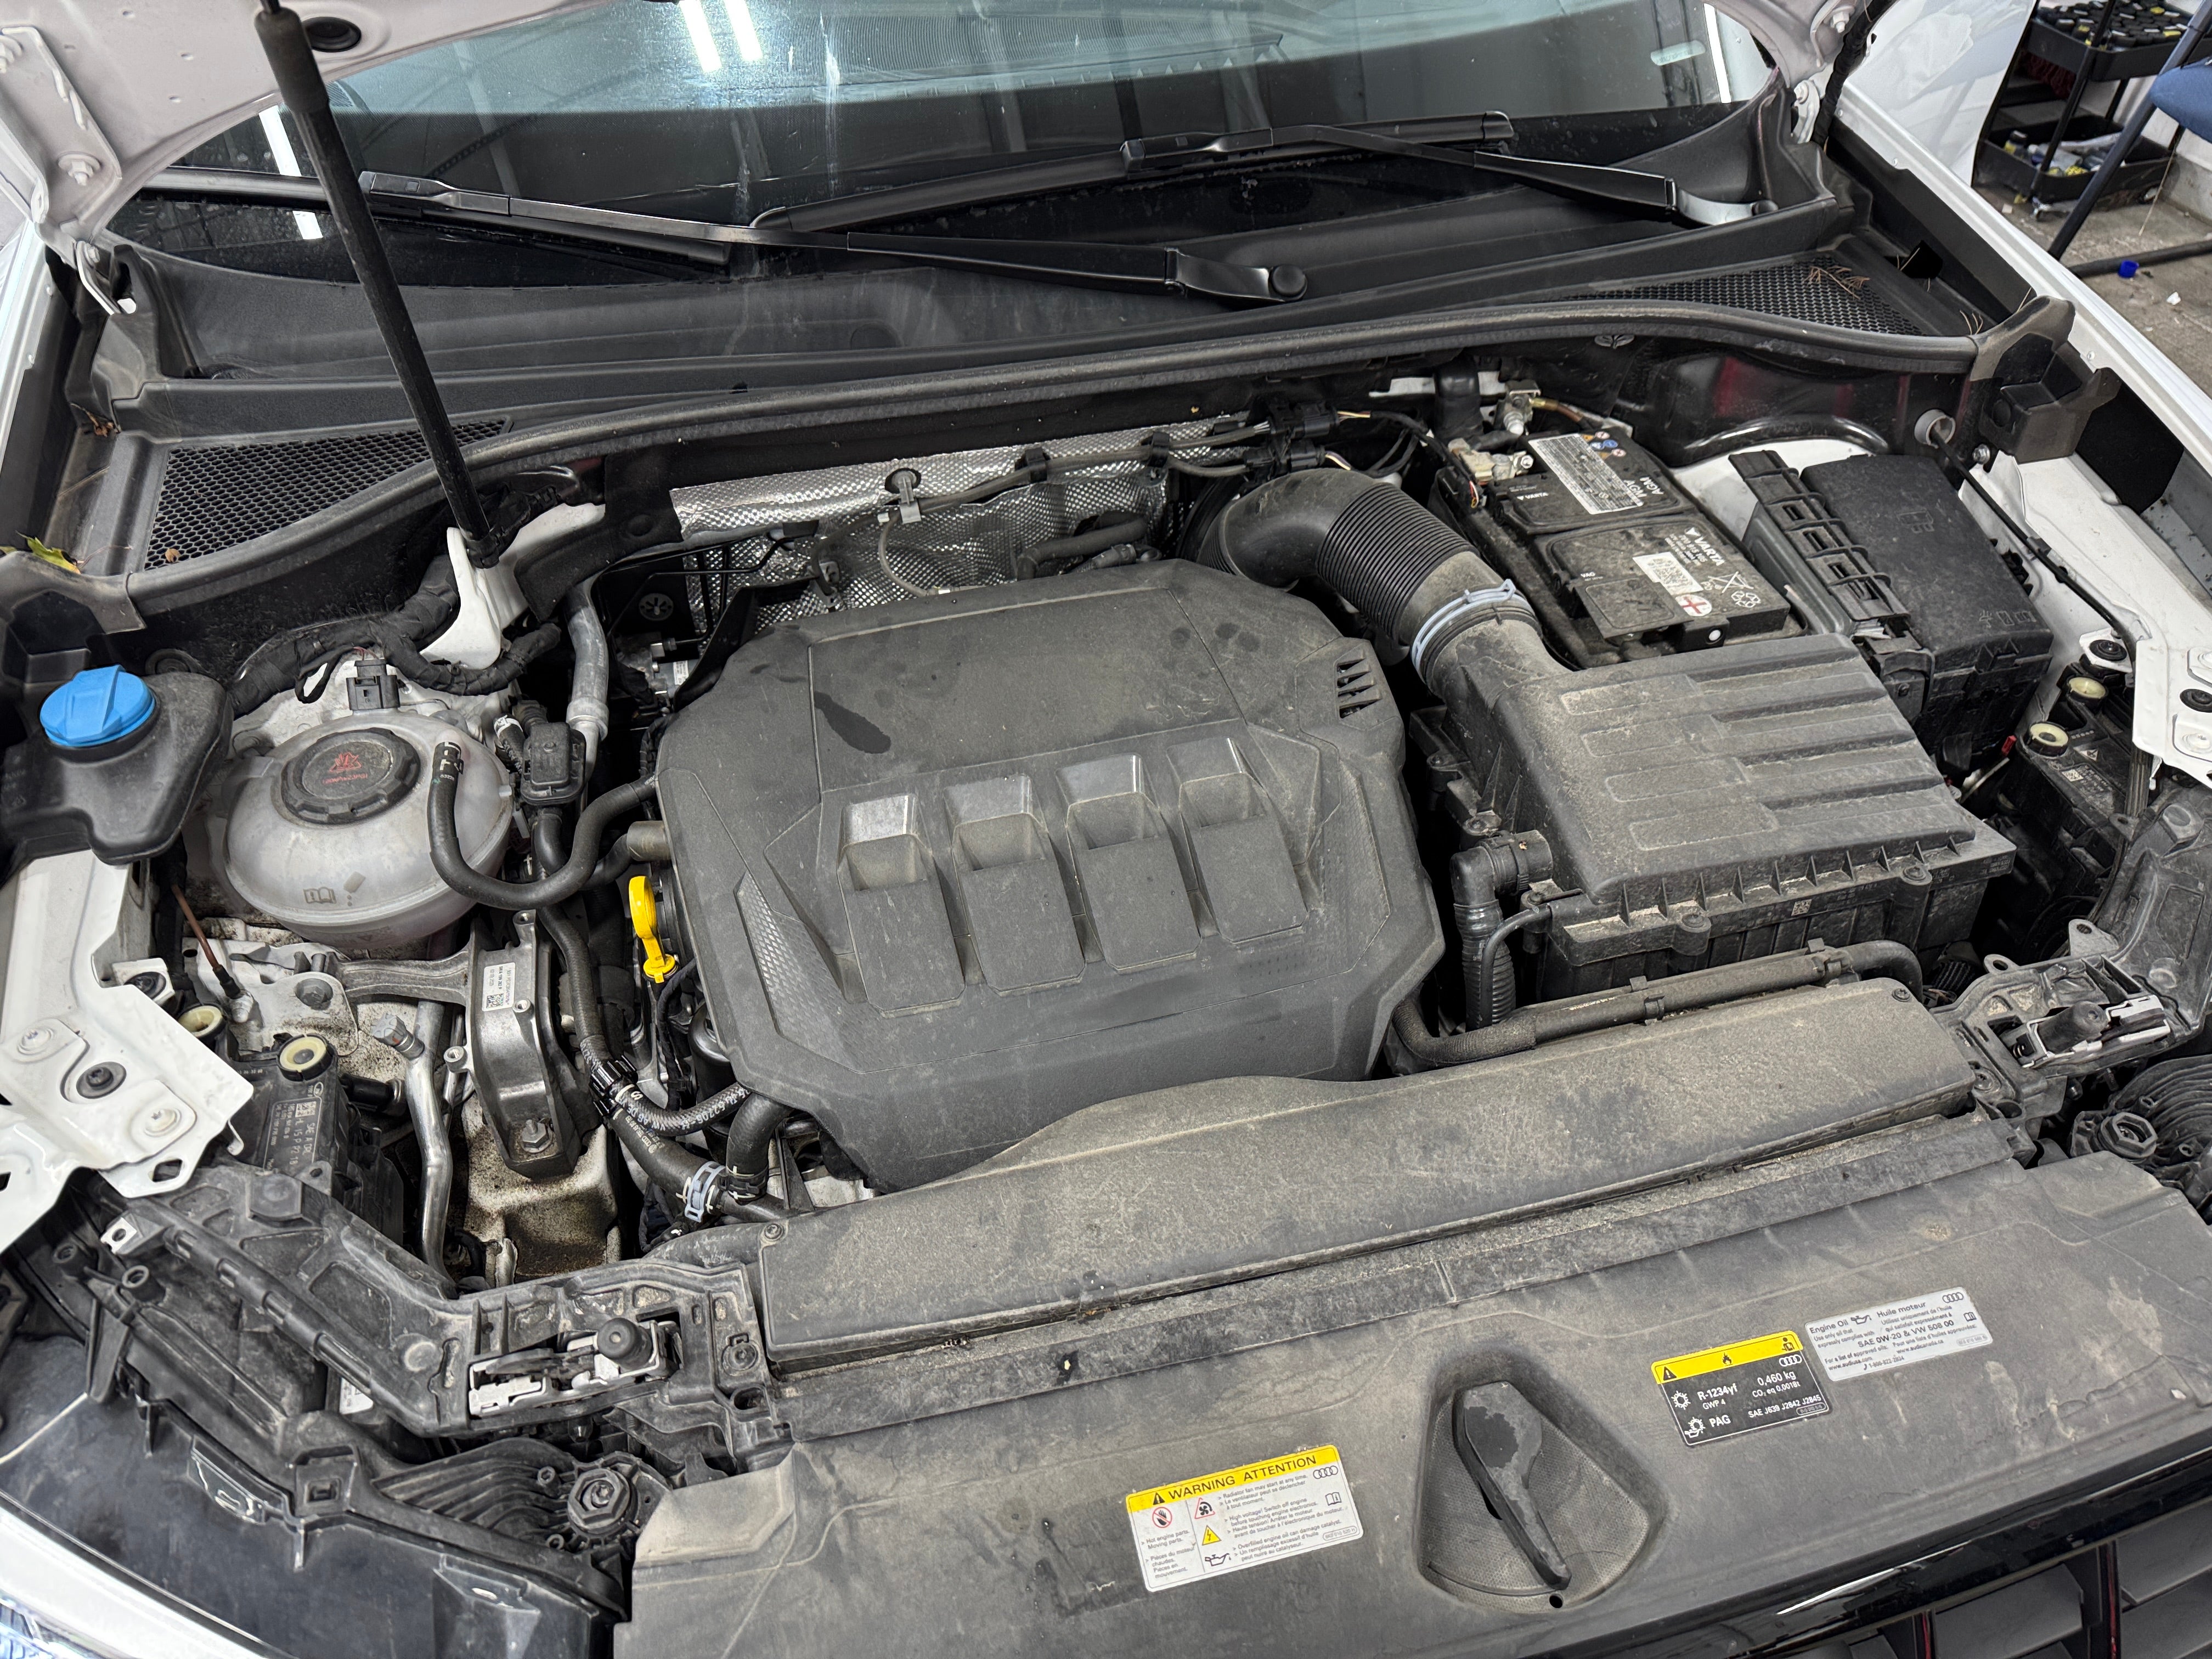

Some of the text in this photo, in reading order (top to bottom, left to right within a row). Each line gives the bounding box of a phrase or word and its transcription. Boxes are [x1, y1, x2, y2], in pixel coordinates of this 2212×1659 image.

[1623, 479, 1647, 498] AGM
[1694, 537, 1726, 566] VARTA
[1876, 1302, 1926, 1318] Huile moteur
[1809, 1324, 1836, 1334] Engine
[1858, 1339, 1875, 1347] SAE
[1876, 1333, 1901, 1343] 0W-20
[1911, 1326, 1926, 1334] VW
[1757, 1371, 1796, 1386] 0,460 kg
[1697, 1383, 1738, 1401] R-1234yf
[1776, 1381, 1801, 1392] 0,0018t
[1702, 1400, 1719, 1409] GWP
[1748, 1409, 1763, 1418] SAE
[1764, 1404, 1780, 1414] J639
[1781, 1400, 1801, 1410] J2842
[1802, 1395, 1821, 1405] J2845
[1709, 1415, 1731, 1427] PAG
[1168, 1455, 1316, 1499] WARNING ATTENTION
[1223, 1490, 1244, 1498] Radiator
[1232, 1492, 1258, 1502] ventilateur
[1279, 1481, 1305, 1491] déclencher
[1242, 1497, 1264, 1506] moment.
[1242, 1508, 1263, 1517] voltage!
[1248, 1513, 1271, 1522] touching
[1289, 1502, 1318, 1511] electronics.
[1248, 1519, 1269, 1528] tension!
[1270, 1515, 1287, 1523] Arrêter
[1256, 1524, 1276, 1532] toucher
[1281, 1514, 1315, 1526] l'électronique
[1238, 1538, 1263, 1549] Overfilled
[1300, 1525, 1320, 1533] damage
[1321, 1519, 1341, 1528] catalyst.
[1176, 1545, 1195, 1554] moteur
[1249, 1542, 1279, 1553] remplissage
[1280, 1535, 1300, 1544] excessif
[1276, 1542, 1304, 1552] catalyseur.
[1152, 1558, 1176, 1567] chaudes.
[1155, 1567, 1188, 1579] mouvement.
